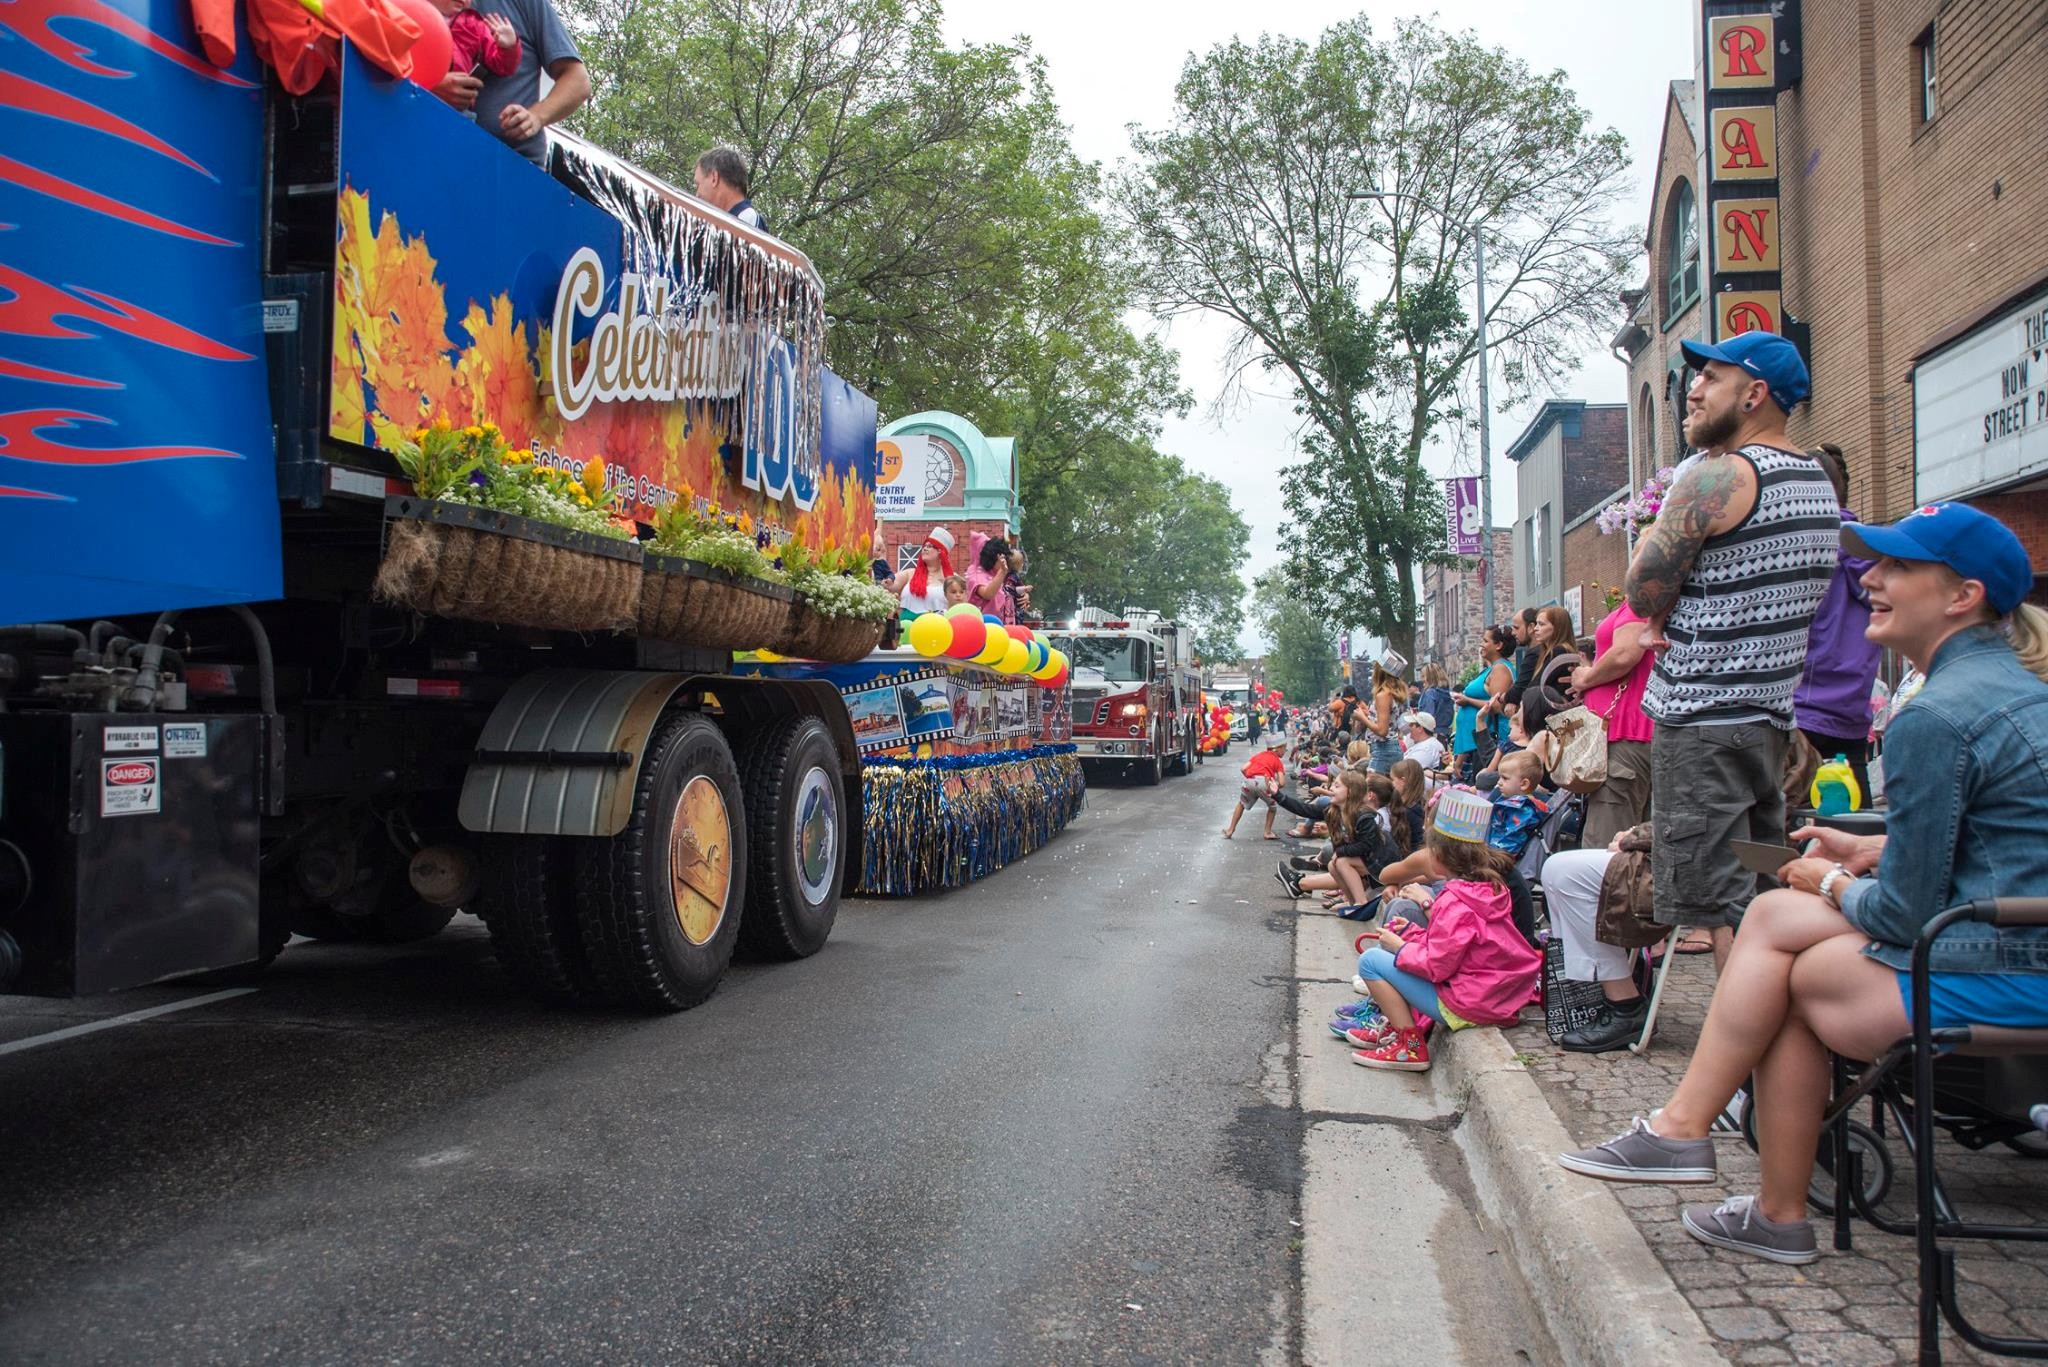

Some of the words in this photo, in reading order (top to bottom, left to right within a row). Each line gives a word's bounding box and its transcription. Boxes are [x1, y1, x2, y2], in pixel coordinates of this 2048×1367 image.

[2002, 359, 2029, 399] NOW
[1984, 396, 2029, 443] STREET
[531, 439, 588, 485] Echoe
[615, 465, 636, 500] the
[638, 474, 680, 516] Centur
[879, 486, 906, 495] ENTRY
[889, 496, 916, 505] THEME
[1446, 479, 1458, 553] DOWNTOWN
[1460, 536, 1478, 545] LIVE
[110, 768, 151, 781] DANGER
